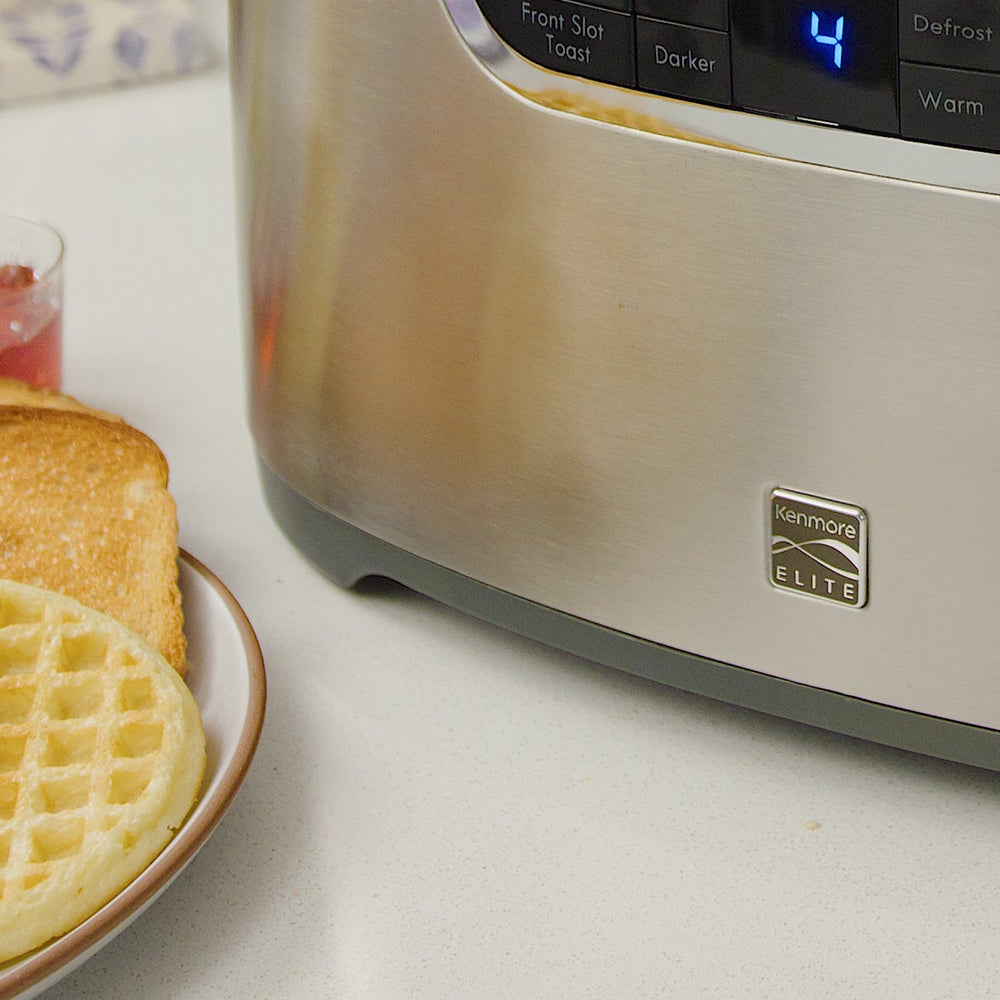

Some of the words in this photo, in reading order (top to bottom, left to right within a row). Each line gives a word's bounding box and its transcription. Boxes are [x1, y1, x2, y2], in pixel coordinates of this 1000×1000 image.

[521, 0, 565, 31] Front
[571, 13, 605, 42] Slot
[913, 13, 993, 42] Defrost
[545, 32, 592, 64] Toast
[809, 9, 845, 69] 4
[655, 43, 717, 74] Darker
[917, 88, 984, 117] Warm
[774, 503, 857, 540] Kenmore
[775, 565, 856, 600] ELITE
